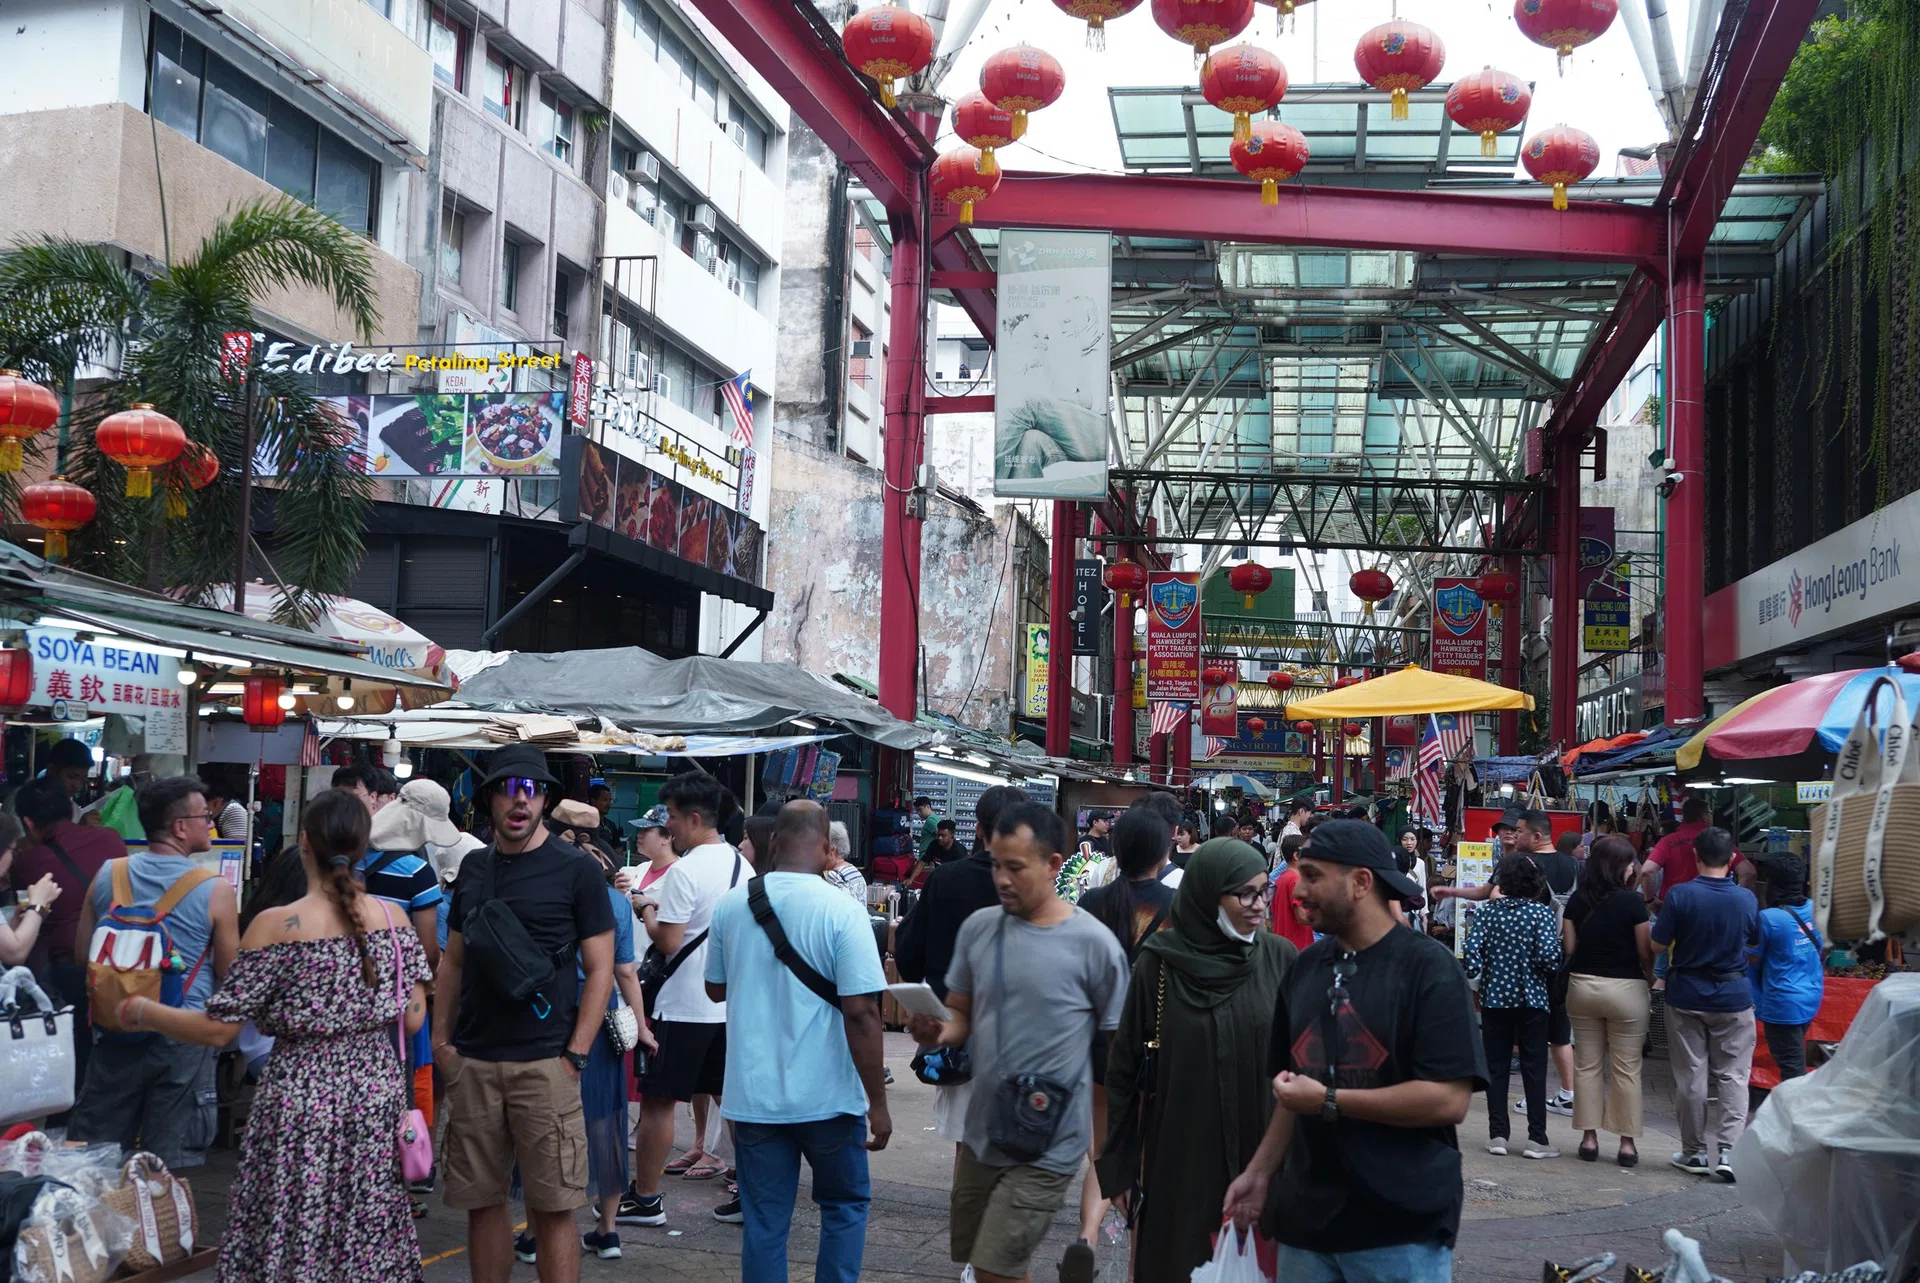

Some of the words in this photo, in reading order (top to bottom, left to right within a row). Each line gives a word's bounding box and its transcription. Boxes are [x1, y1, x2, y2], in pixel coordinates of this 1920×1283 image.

[261, 340, 397, 375] Edibee
[405, 352, 490, 376] Petaling
[498, 351, 562, 370] Street
[445, 376, 467, 387] KEDAI
[590, 381, 659, 449] Edibee
[1805, 558, 1867, 613] HongLeong
[1870, 537, 1901, 586] Bank
[1077, 581, 1087, 646] HOEL
[38, 636, 96, 667] SOYA
[103, 647, 159, 676] BEAN
[369, 645, 416, 668] Wall's
[1576, 695, 1604, 743] PANDA
[1605, 687, 1632, 738] EYES
[1243, 742, 1278, 750] STREET
[1840, 739, 1862, 781] Chloé
[1887, 723, 1905, 768] Chloé
[9, 1044, 66, 1062] CHANEL
[139, 1186, 157, 1238] CHRISTIAN
